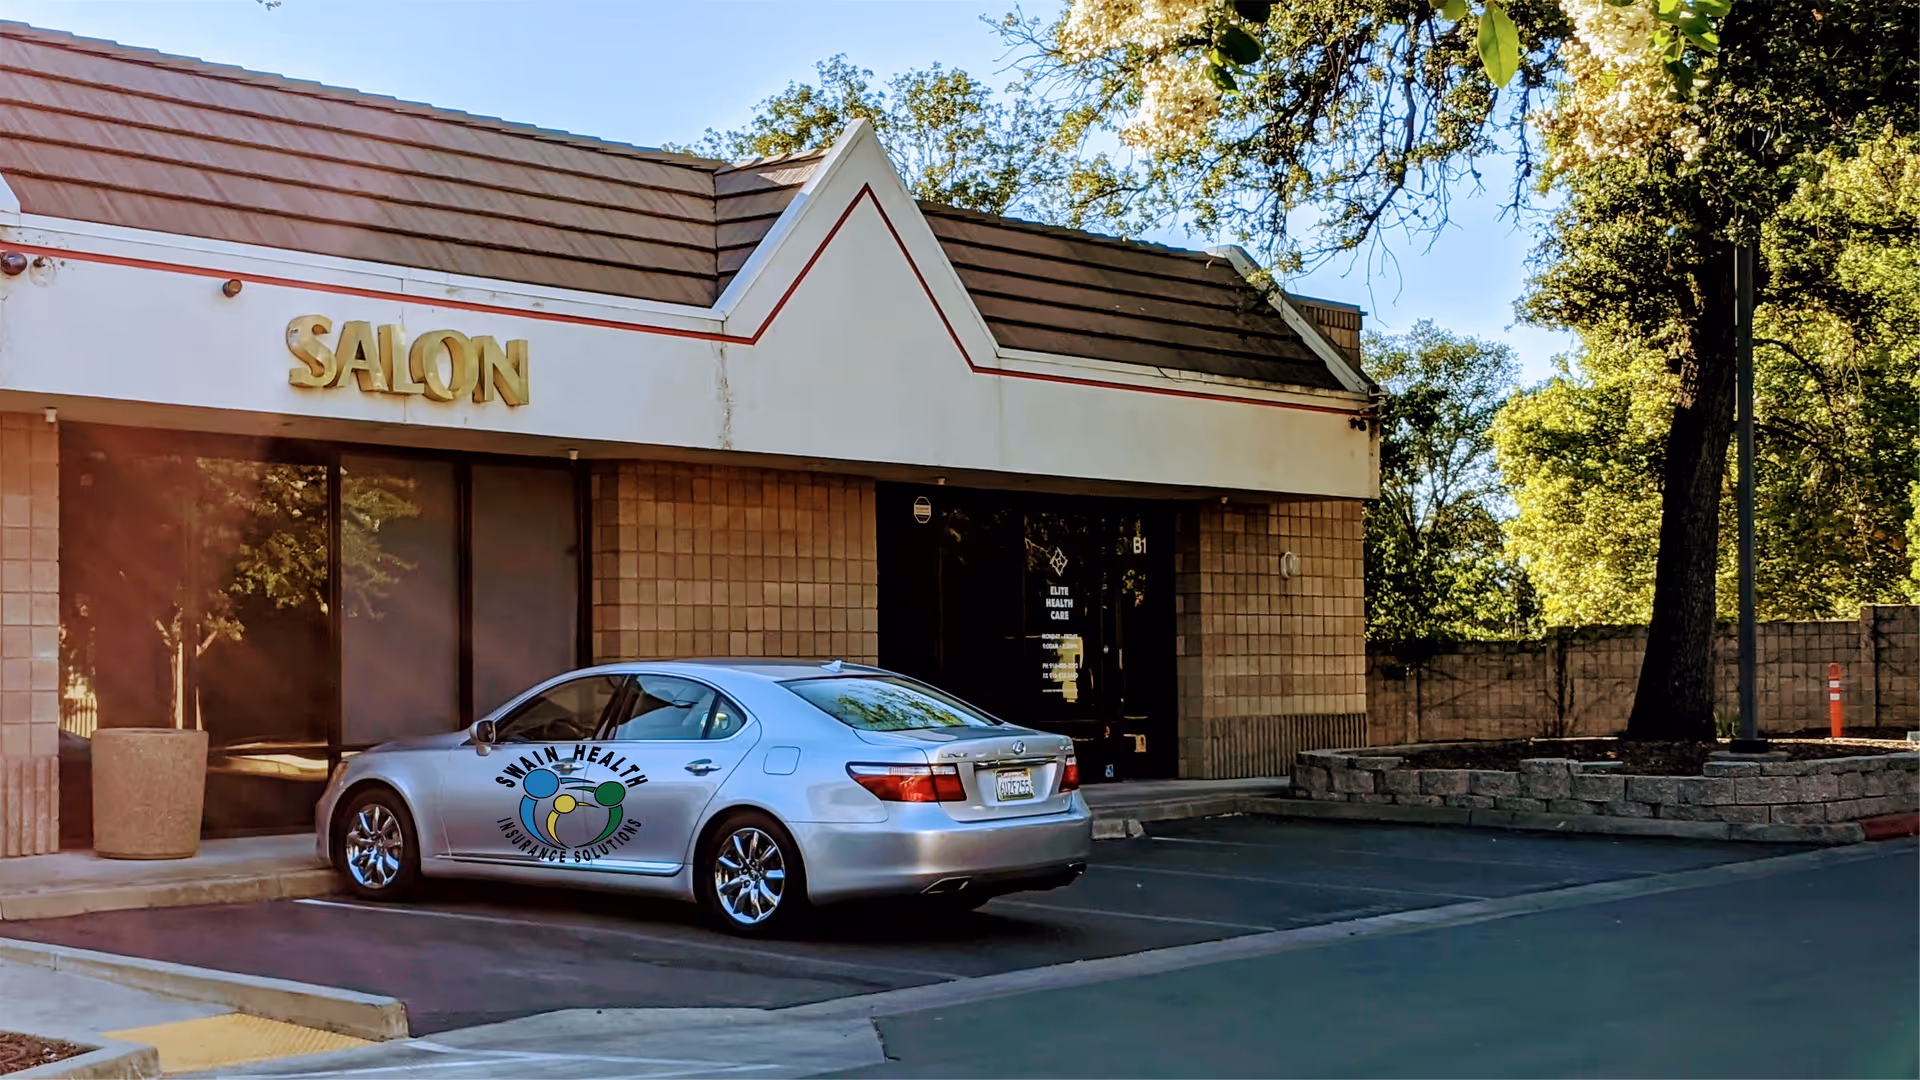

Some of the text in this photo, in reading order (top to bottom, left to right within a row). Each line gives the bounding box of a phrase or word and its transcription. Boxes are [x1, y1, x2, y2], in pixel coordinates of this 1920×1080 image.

[286, 314, 529, 406] SALON
[1133, 536, 1146, 554] B1
[1050, 586, 1069, 596] ELITE
[1046, 598, 1074, 608] HEALTH
[1050, 610, 1069, 620] CARE
[495, 744, 648, 788] SWAIN HEALTH
[497, 817, 642, 864] INSURANCE SOLUTIONS
